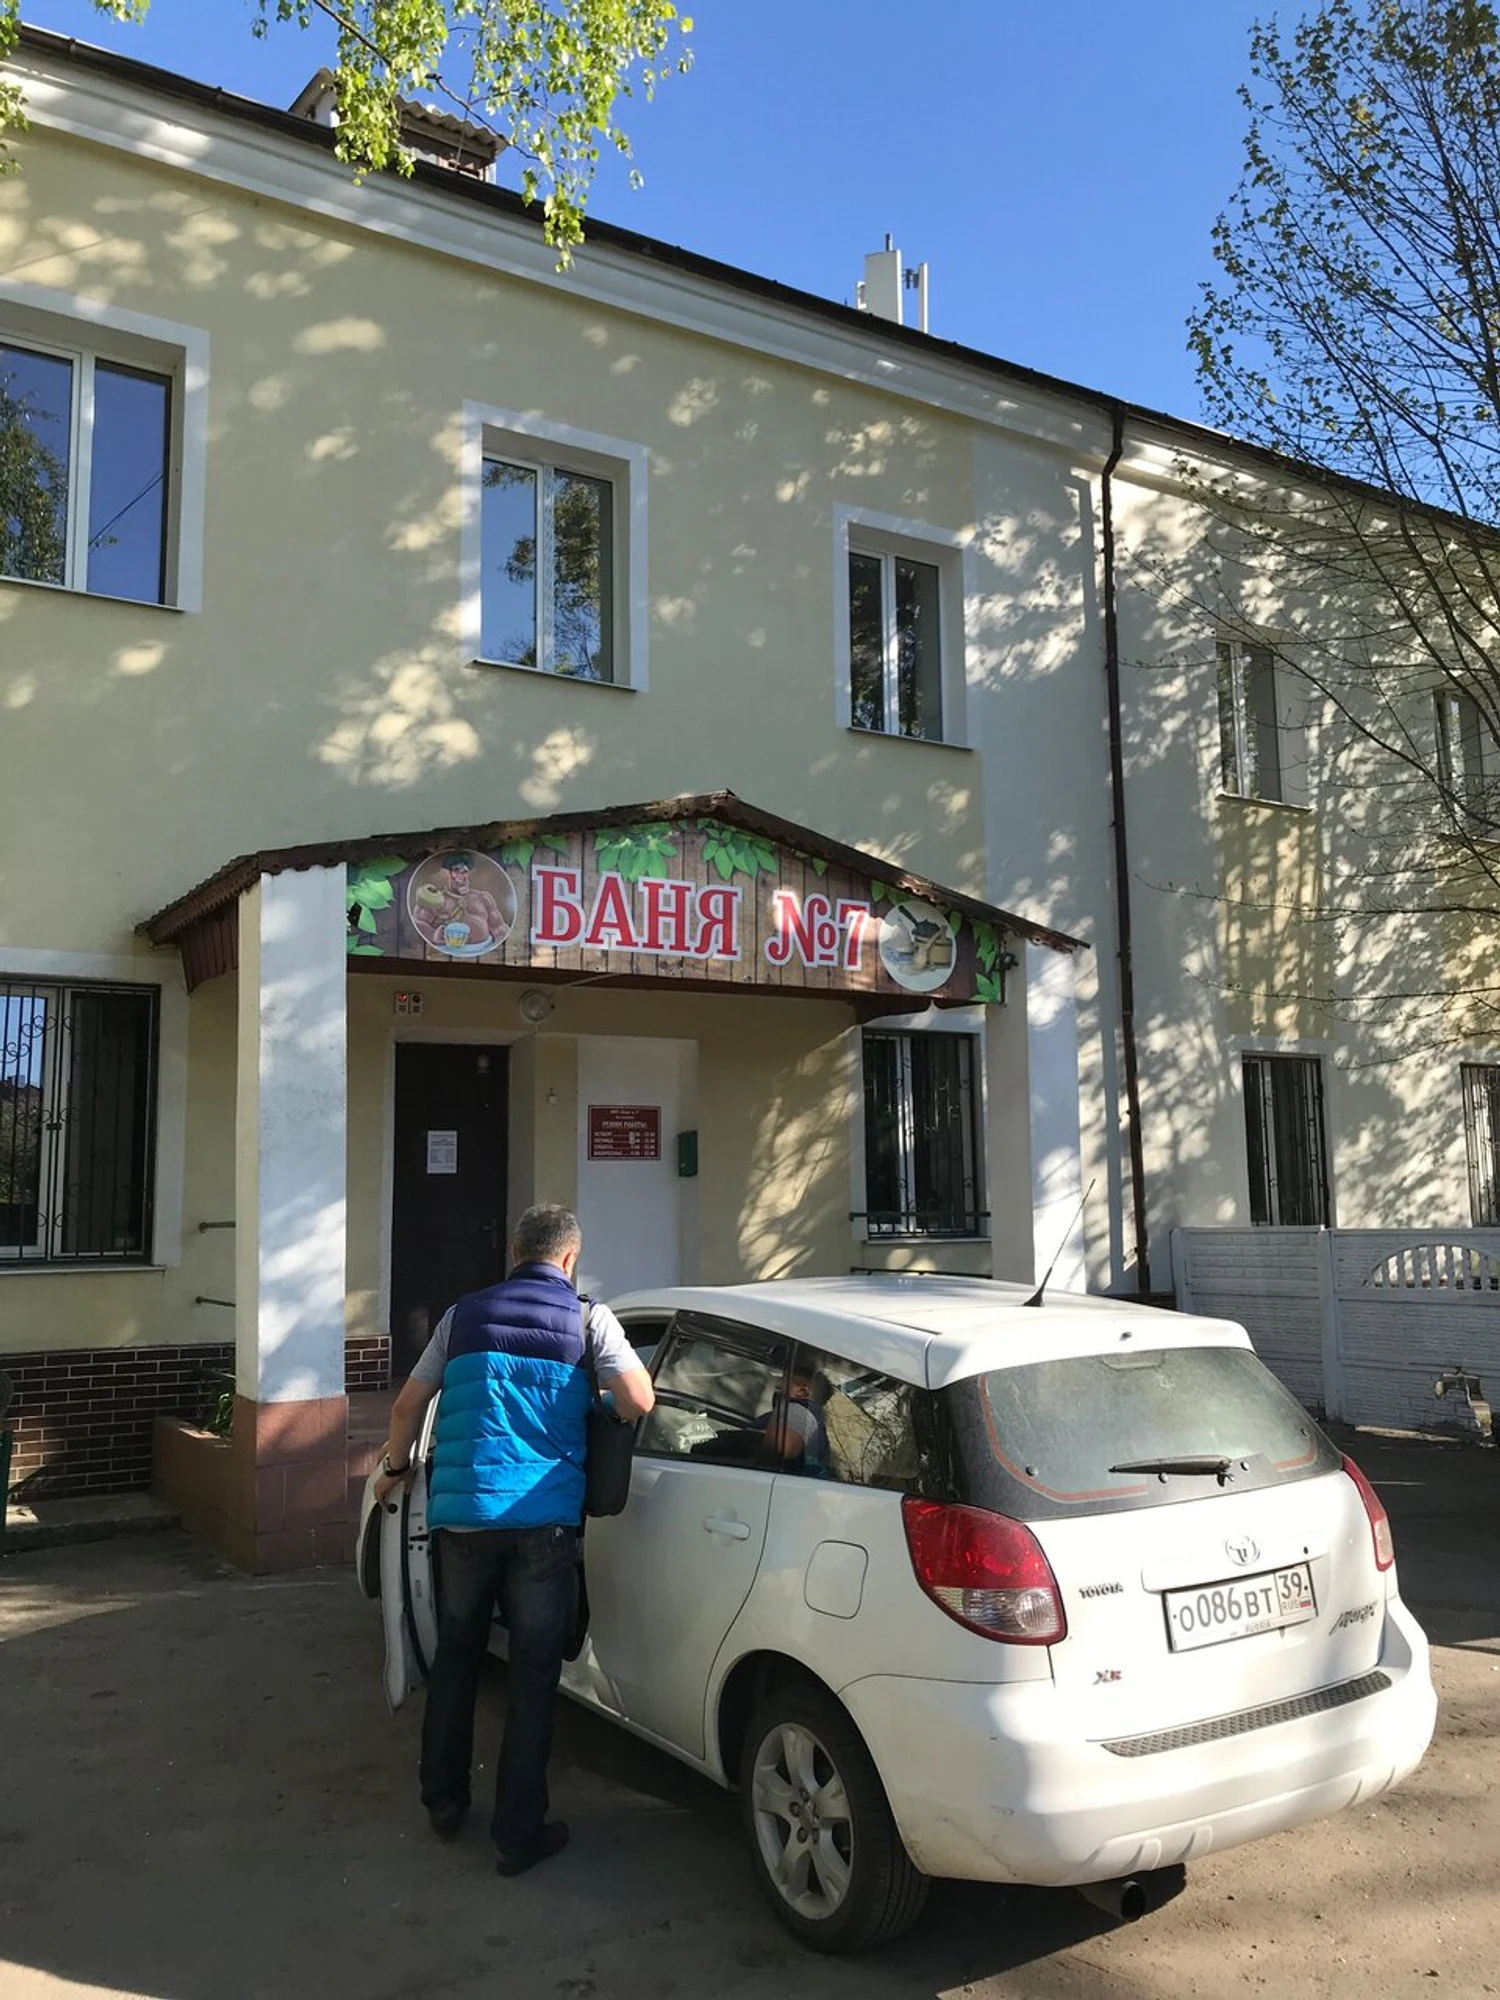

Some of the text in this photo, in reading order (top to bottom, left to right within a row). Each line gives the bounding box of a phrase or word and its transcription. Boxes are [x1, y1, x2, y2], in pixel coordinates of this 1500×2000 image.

[531, 865, 869, 970] БАНЯ №7
[1078, 1582, 1123, 1599] TOYOTA
[1278, 1572, 1302, 1600] 39
[1281, 1600, 1300, 1611] RUS
